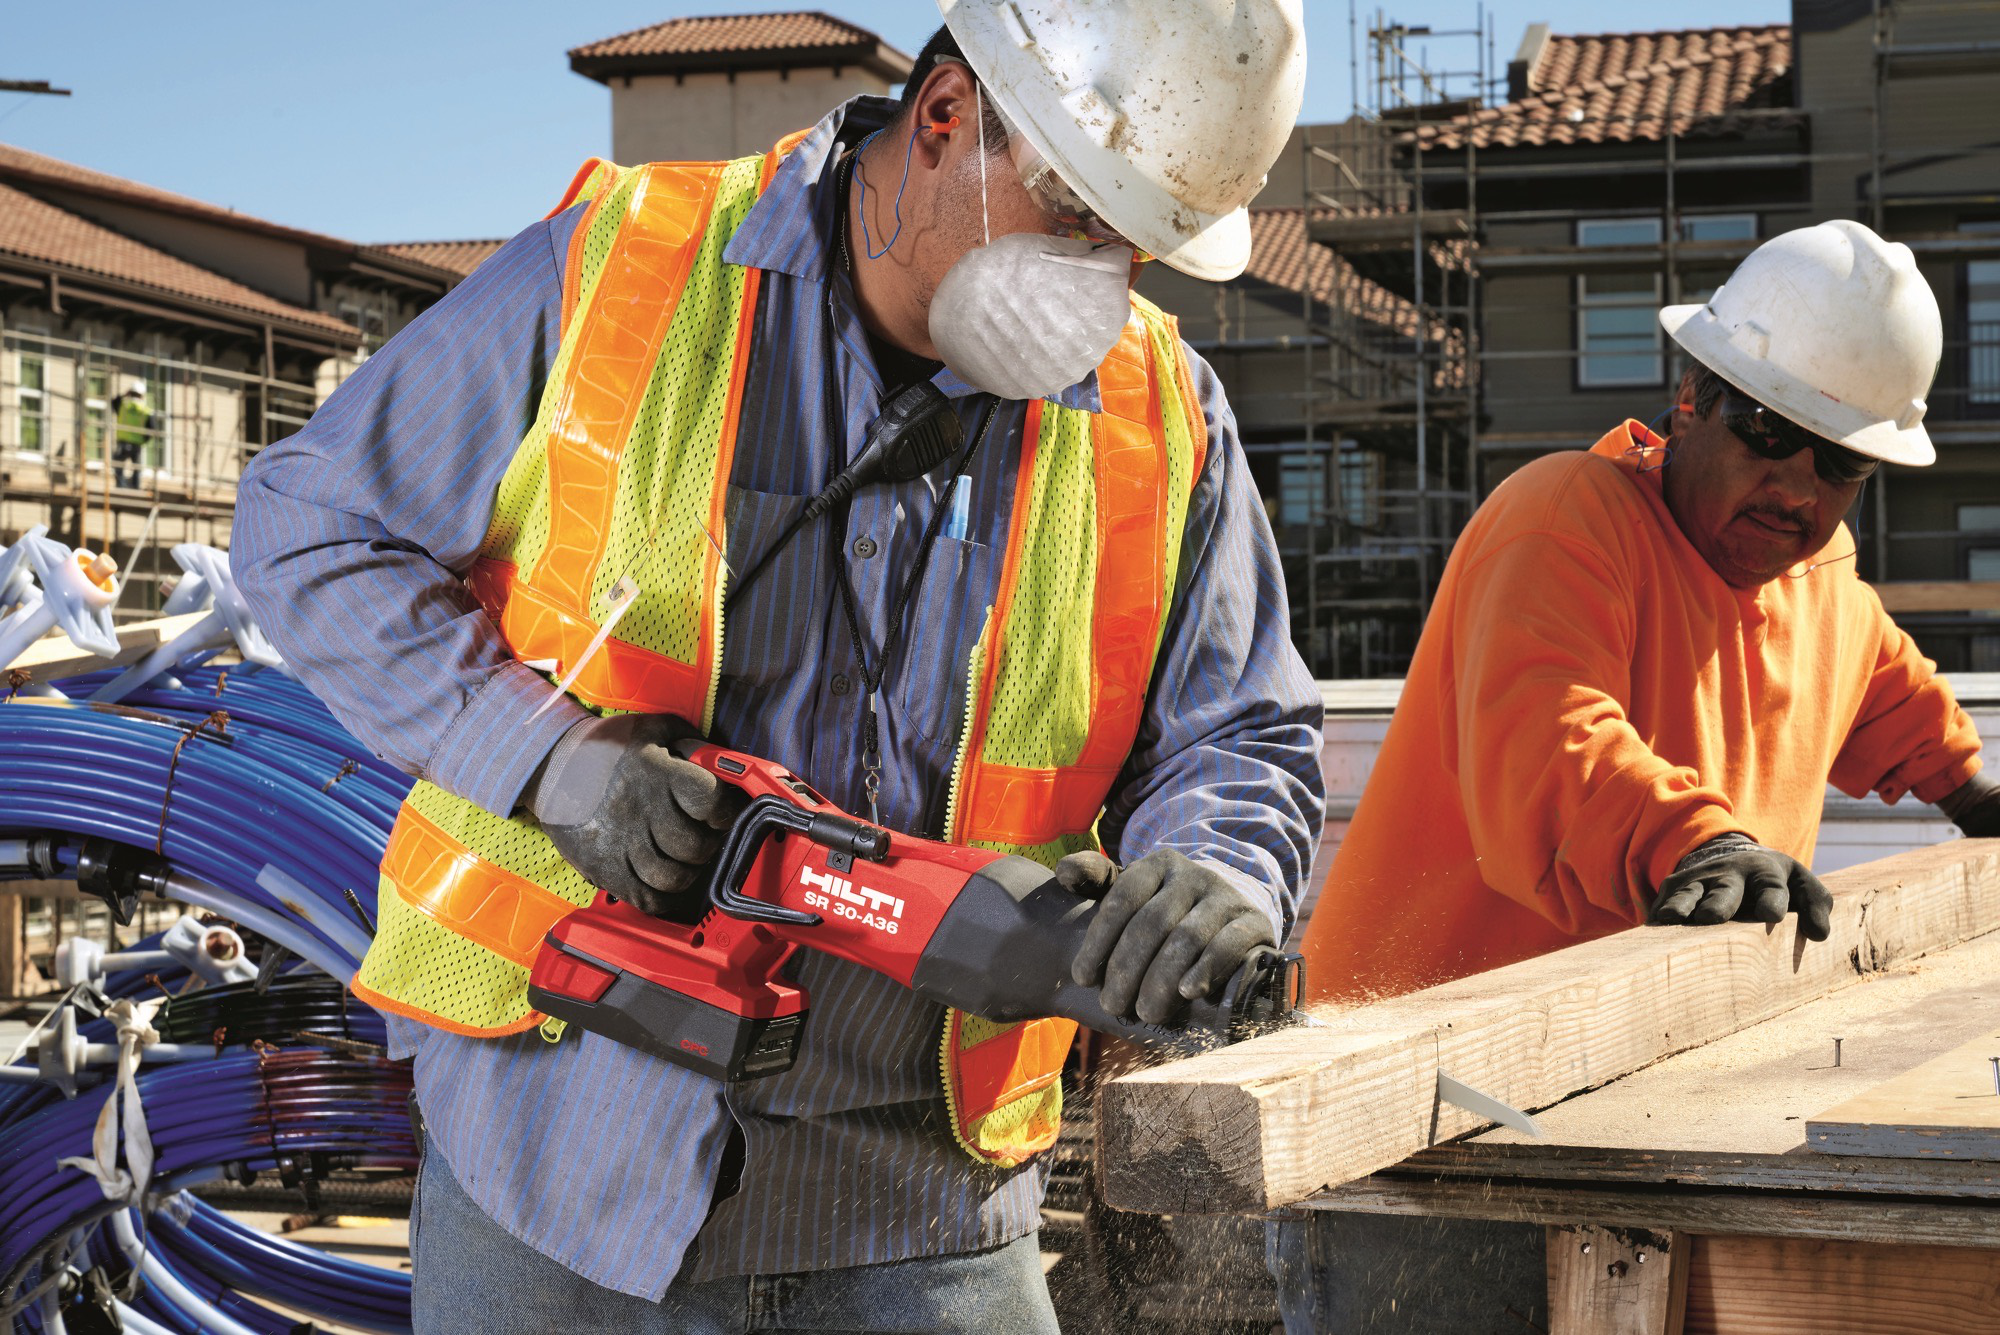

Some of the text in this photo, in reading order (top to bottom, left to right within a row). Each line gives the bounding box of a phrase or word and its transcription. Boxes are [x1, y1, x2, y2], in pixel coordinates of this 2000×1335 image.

[800, 865, 905, 919] HILTI
[804, 891, 899, 935] SR 30-A36
[680, 1039, 709, 1056] CPC
